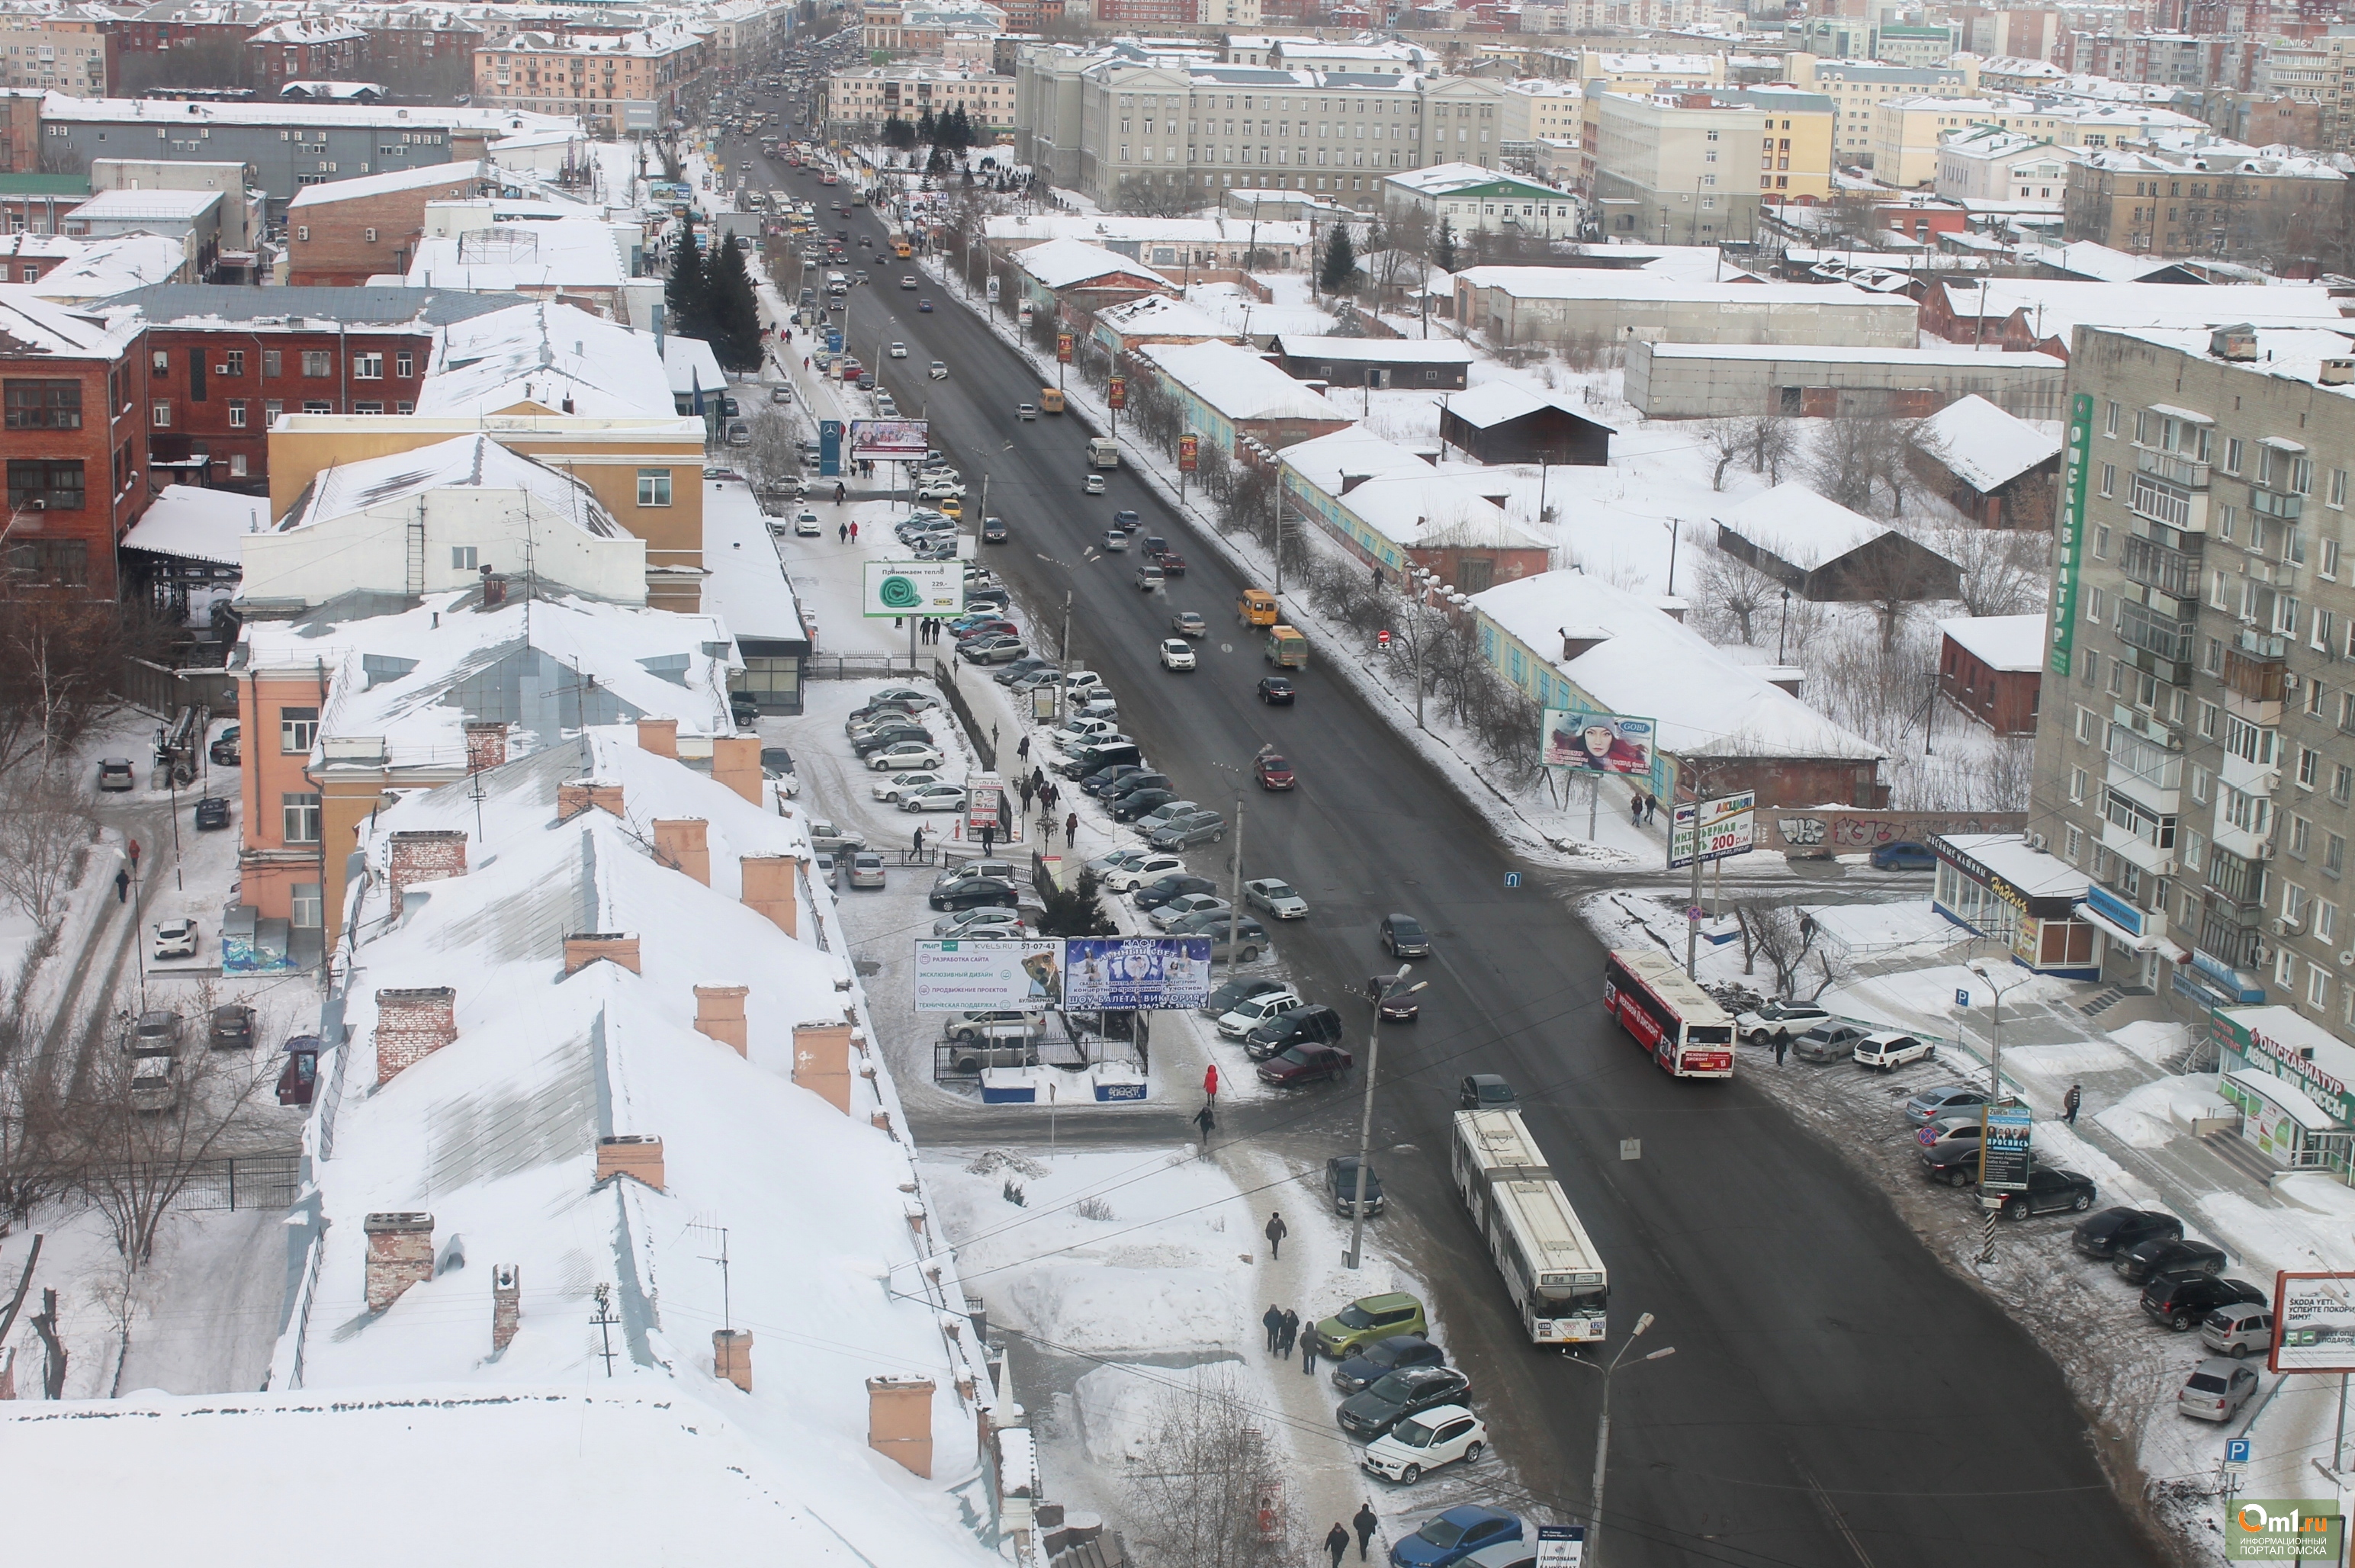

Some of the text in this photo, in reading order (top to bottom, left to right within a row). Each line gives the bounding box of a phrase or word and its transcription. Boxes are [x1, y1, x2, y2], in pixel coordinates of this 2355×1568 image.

[2054, 426, 2081, 642] ОМСКАВИАТУР
[1711, 834, 1735, 851] 200
[1956, 853, 1986, 878] МАШИНЫ
[1099, 946, 1178, 962] ЛУННЫЙ СВЕТ
[1068, 995, 1137, 1004] ШОУ-БАЛЕТА
[1958, 990, 1967, 1004] P
[1619, 994, 1659, 1039] МЕХОВОЙ ДИСКОНТ
[2259, 1036, 2344, 1096] ОМСКАВИАТУР
[2244, 1045, 2276, 1076] АВИА
[2304, 1081, 2347, 1120] КАССЫ
[1987, 1138, 2029, 1147] ПРОСНИСЬ
[2231, 1442, 2244, 1460] P
